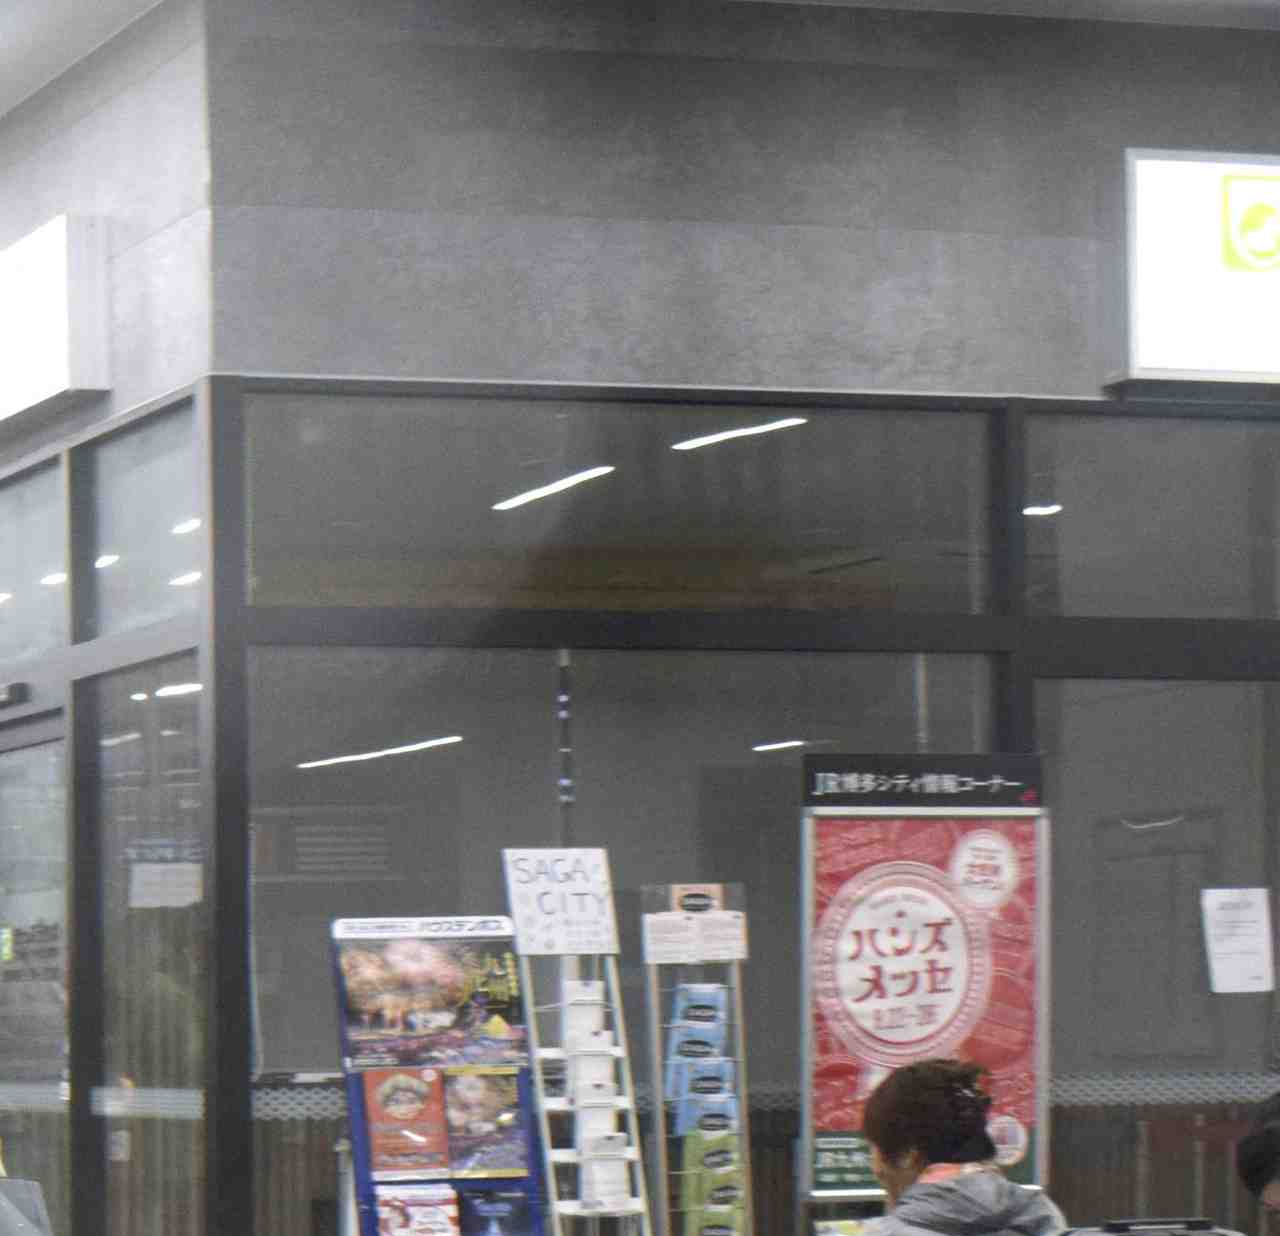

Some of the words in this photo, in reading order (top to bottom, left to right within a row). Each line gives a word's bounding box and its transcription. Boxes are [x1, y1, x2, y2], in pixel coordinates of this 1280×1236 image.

[513, 857, 591, 884] SAGA
[537, 891, 610, 915] CITY
[848, 911, 954, 961] ハンズ
[852, 959, 954, 1003] メッセ
